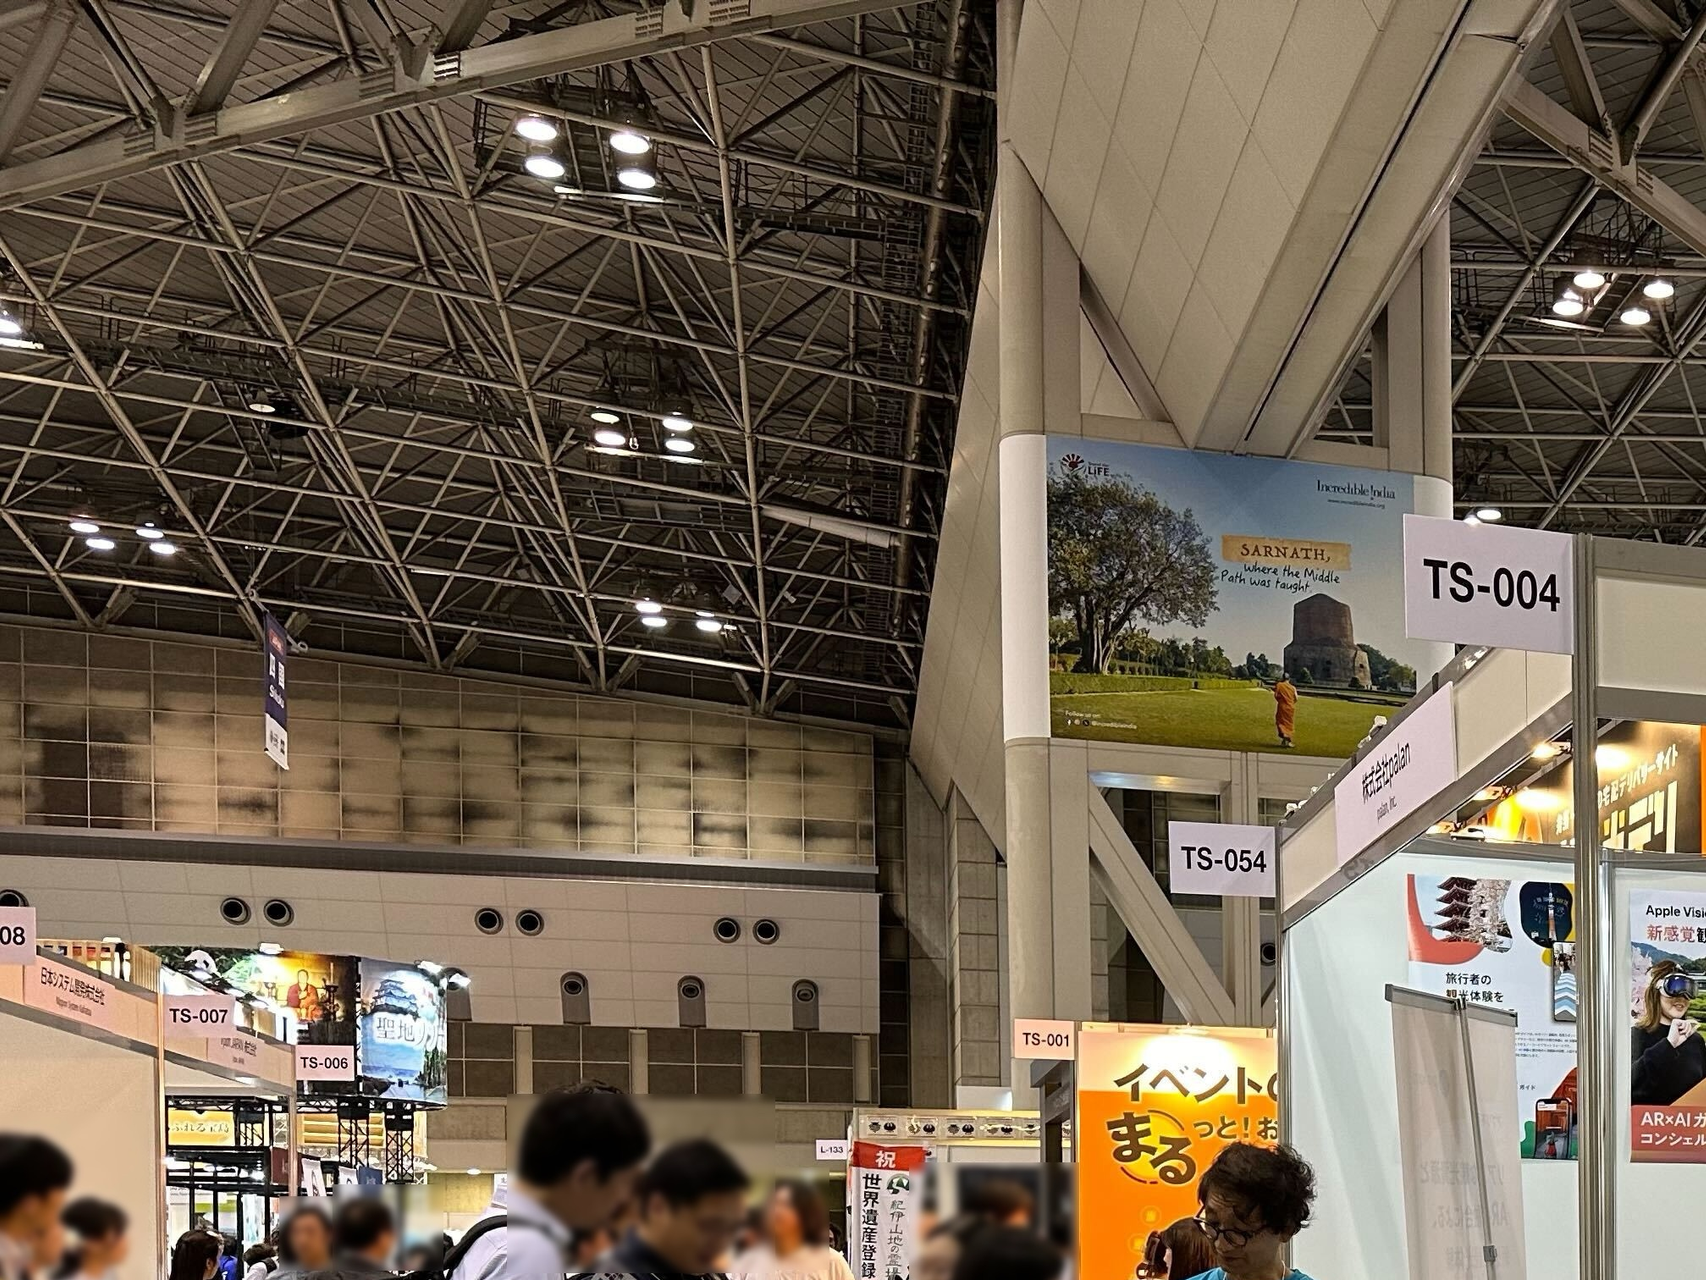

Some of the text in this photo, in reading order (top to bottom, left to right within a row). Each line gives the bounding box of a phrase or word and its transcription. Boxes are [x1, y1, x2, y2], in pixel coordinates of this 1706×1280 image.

[1087, 466, 1110, 476] LiFE
[1317, 479, 1370, 498] Incredible
[1240, 543, 1332, 563] SARNATH,
[1221, 570, 1246, 585] Path
[1250, 577, 1271, 588] was
[1244, 562, 1341, 584] where the Middle
[1424, 558, 1561, 613] TS-004
[1361, 742, 1411, 804] 株式会社palan
[1181, 845, 1268, 873] TS-054
[1646, 905, 1681, 918] Apple
[1446, 972, 1492, 986] 旅行者の
[169, 1008, 229, 1024] TS-007
[1022, 1032, 1070, 1047] TS-001
[300, 1057, 349, 1069] TS-006
[820, 1146, 844, 1154] L-133
[875, 1150, 896, 1169] 祝
[861, 1173, 882, 1280] 世界遺産登録
